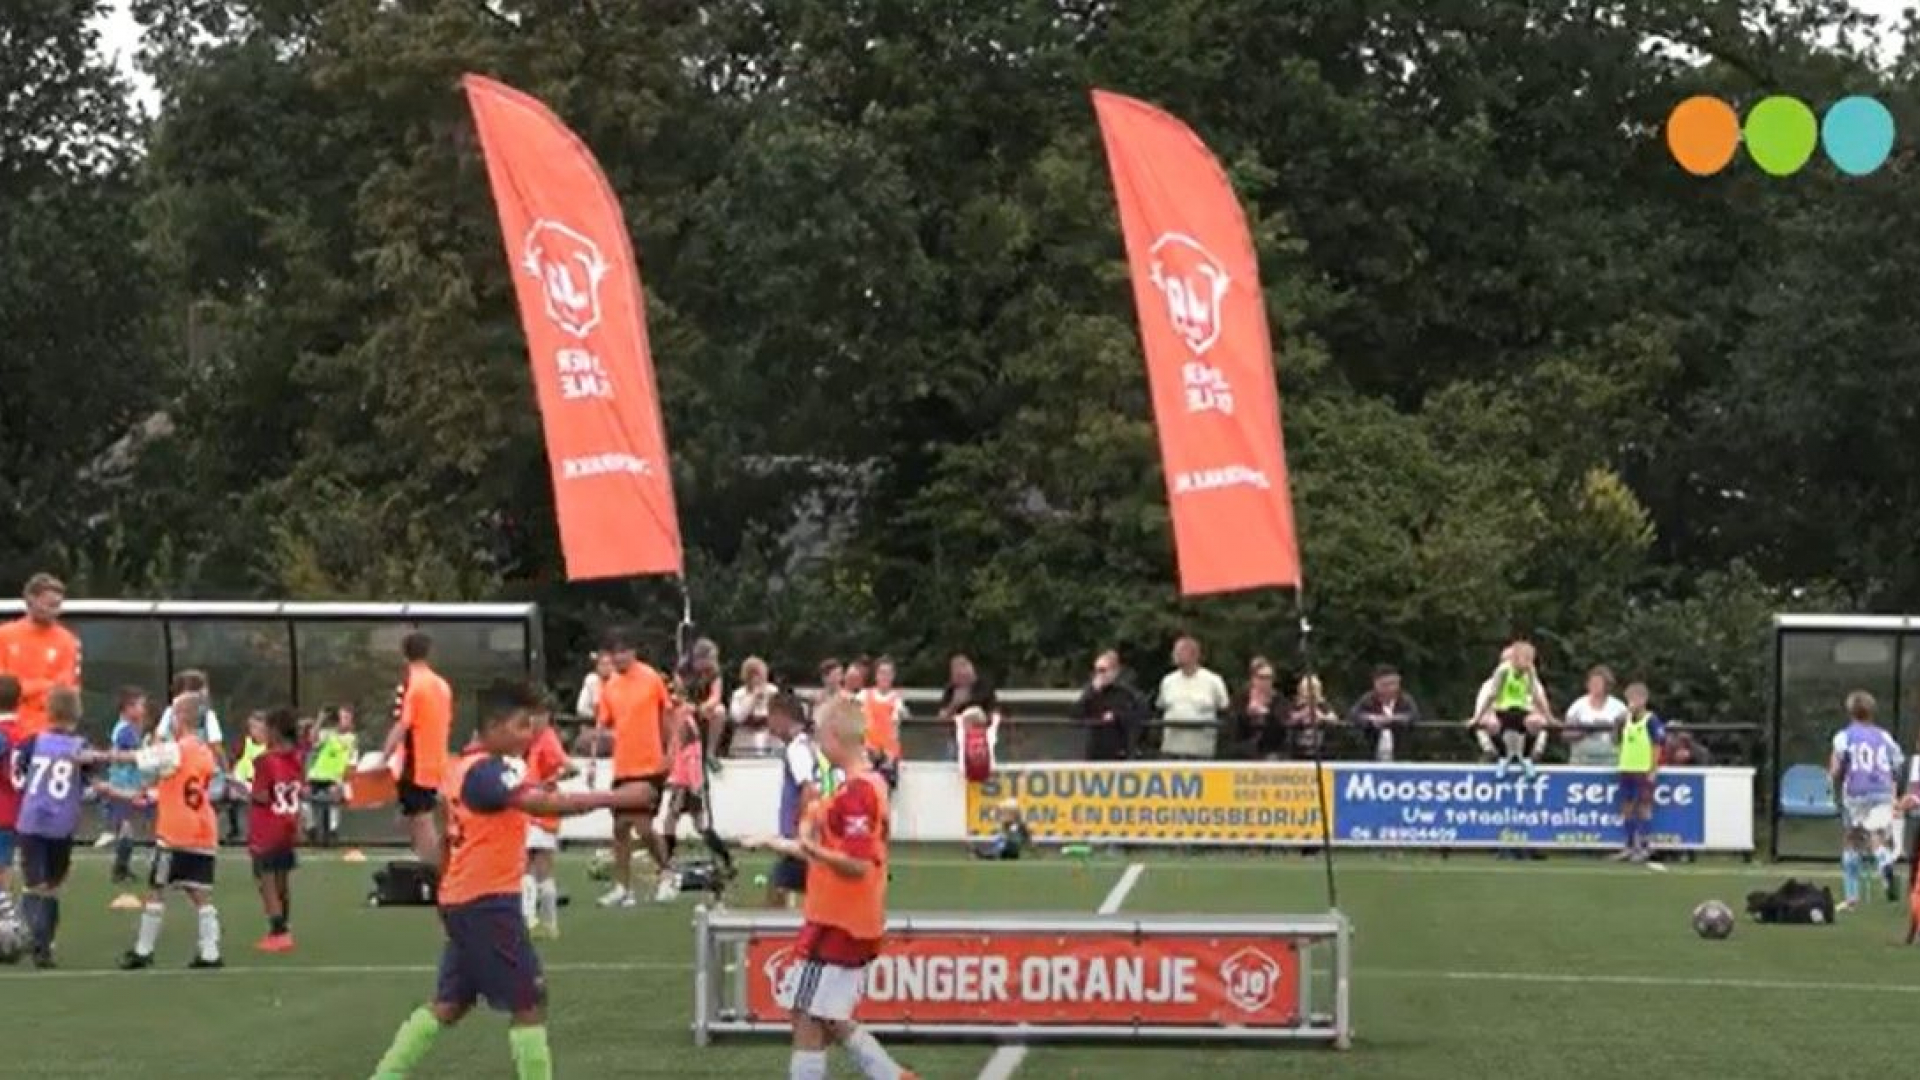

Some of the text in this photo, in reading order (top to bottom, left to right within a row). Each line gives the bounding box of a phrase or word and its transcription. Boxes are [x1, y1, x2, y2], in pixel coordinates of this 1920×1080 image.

[28, 756, 72, 800] 78
[979, 769, 1204, 799] STOUWDAM
[1345, 772, 1550, 805] Moossdorff
[1566, 780, 1693, 806] serce
[1072, 804, 1102, 825] EN
[1402, 806, 1436, 824] Uw
[863, 955, 1198, 1002] ONGER ORANJE
[1234, 970, 1266, 995] JO
